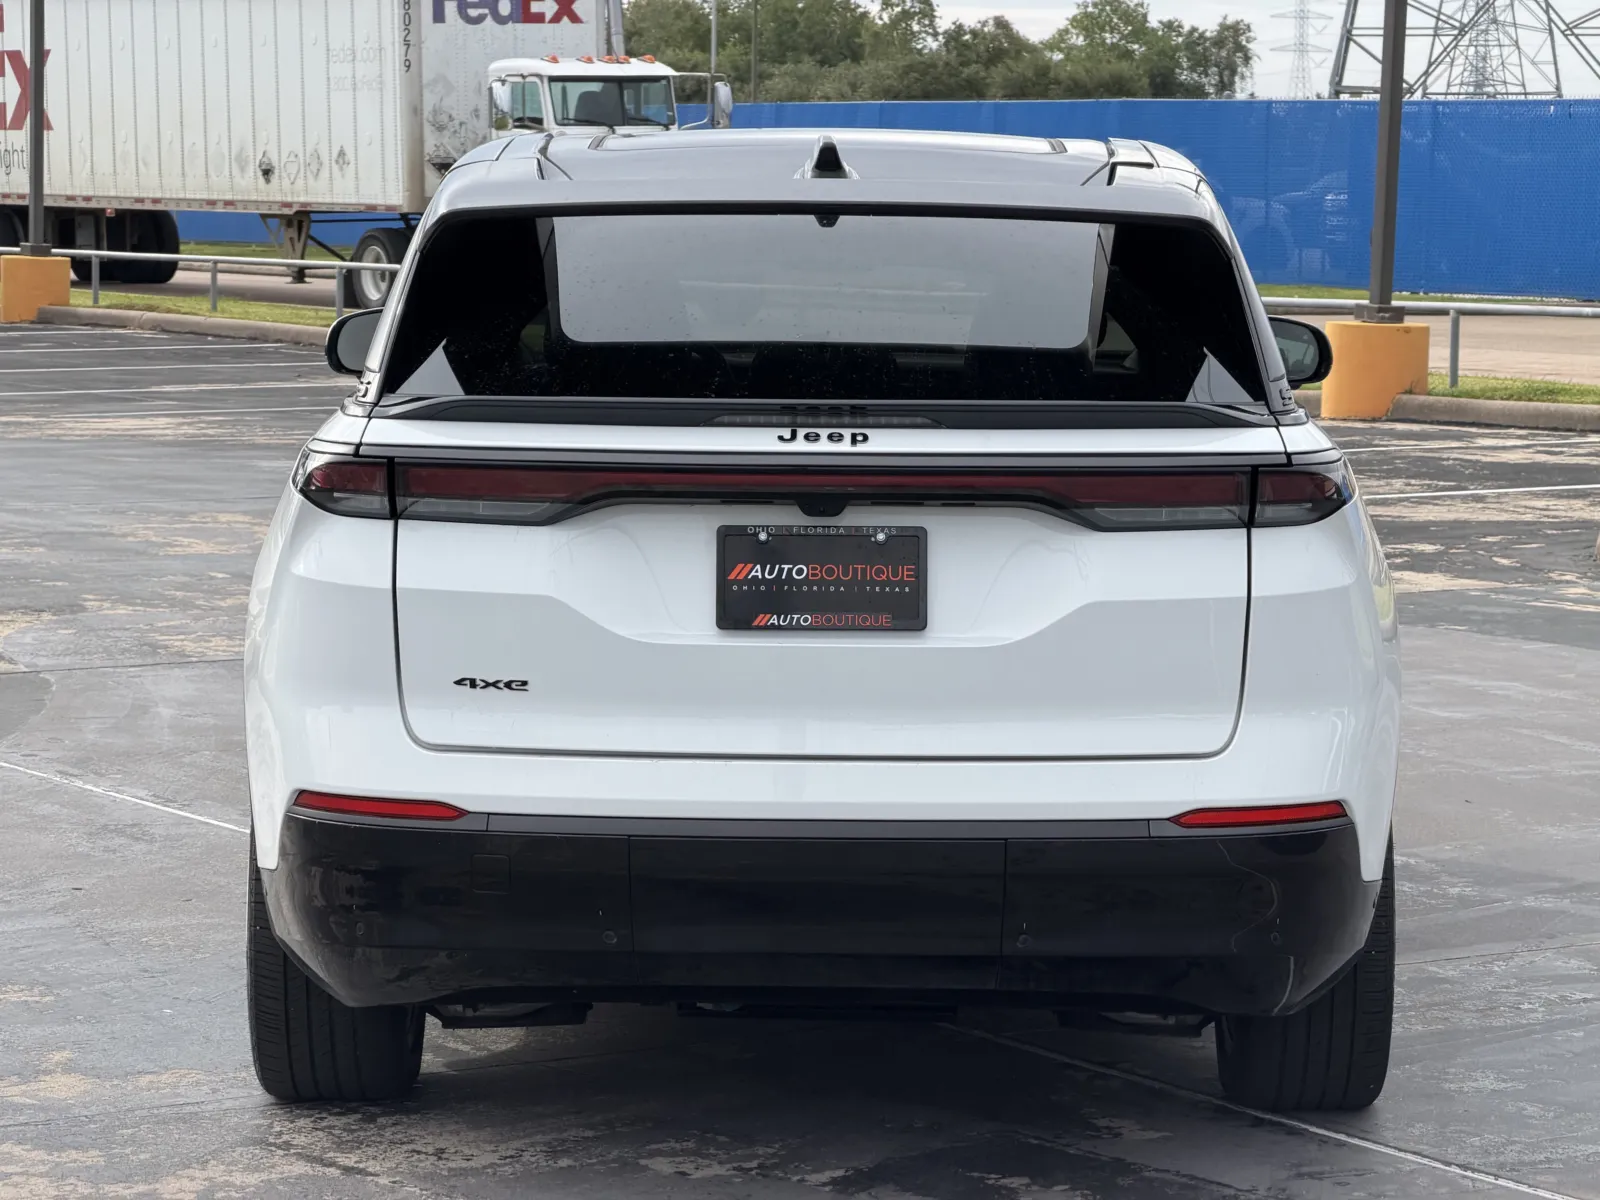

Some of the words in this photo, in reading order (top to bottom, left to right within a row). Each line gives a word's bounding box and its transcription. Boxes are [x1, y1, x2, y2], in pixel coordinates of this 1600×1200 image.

[777, 428, 869, 447] Jeep
[747, 526, 775, 534] OHIO
[793, 526, 845, 534] FLORIDA
[862, 527, 897, 535] TEXAS
[747, 564, 916, 581] AUTOBOUTIQUE
[767, 614, 892, 627] AUTOBOUTIQUE
[453, 677, 529, 691] 4xe
